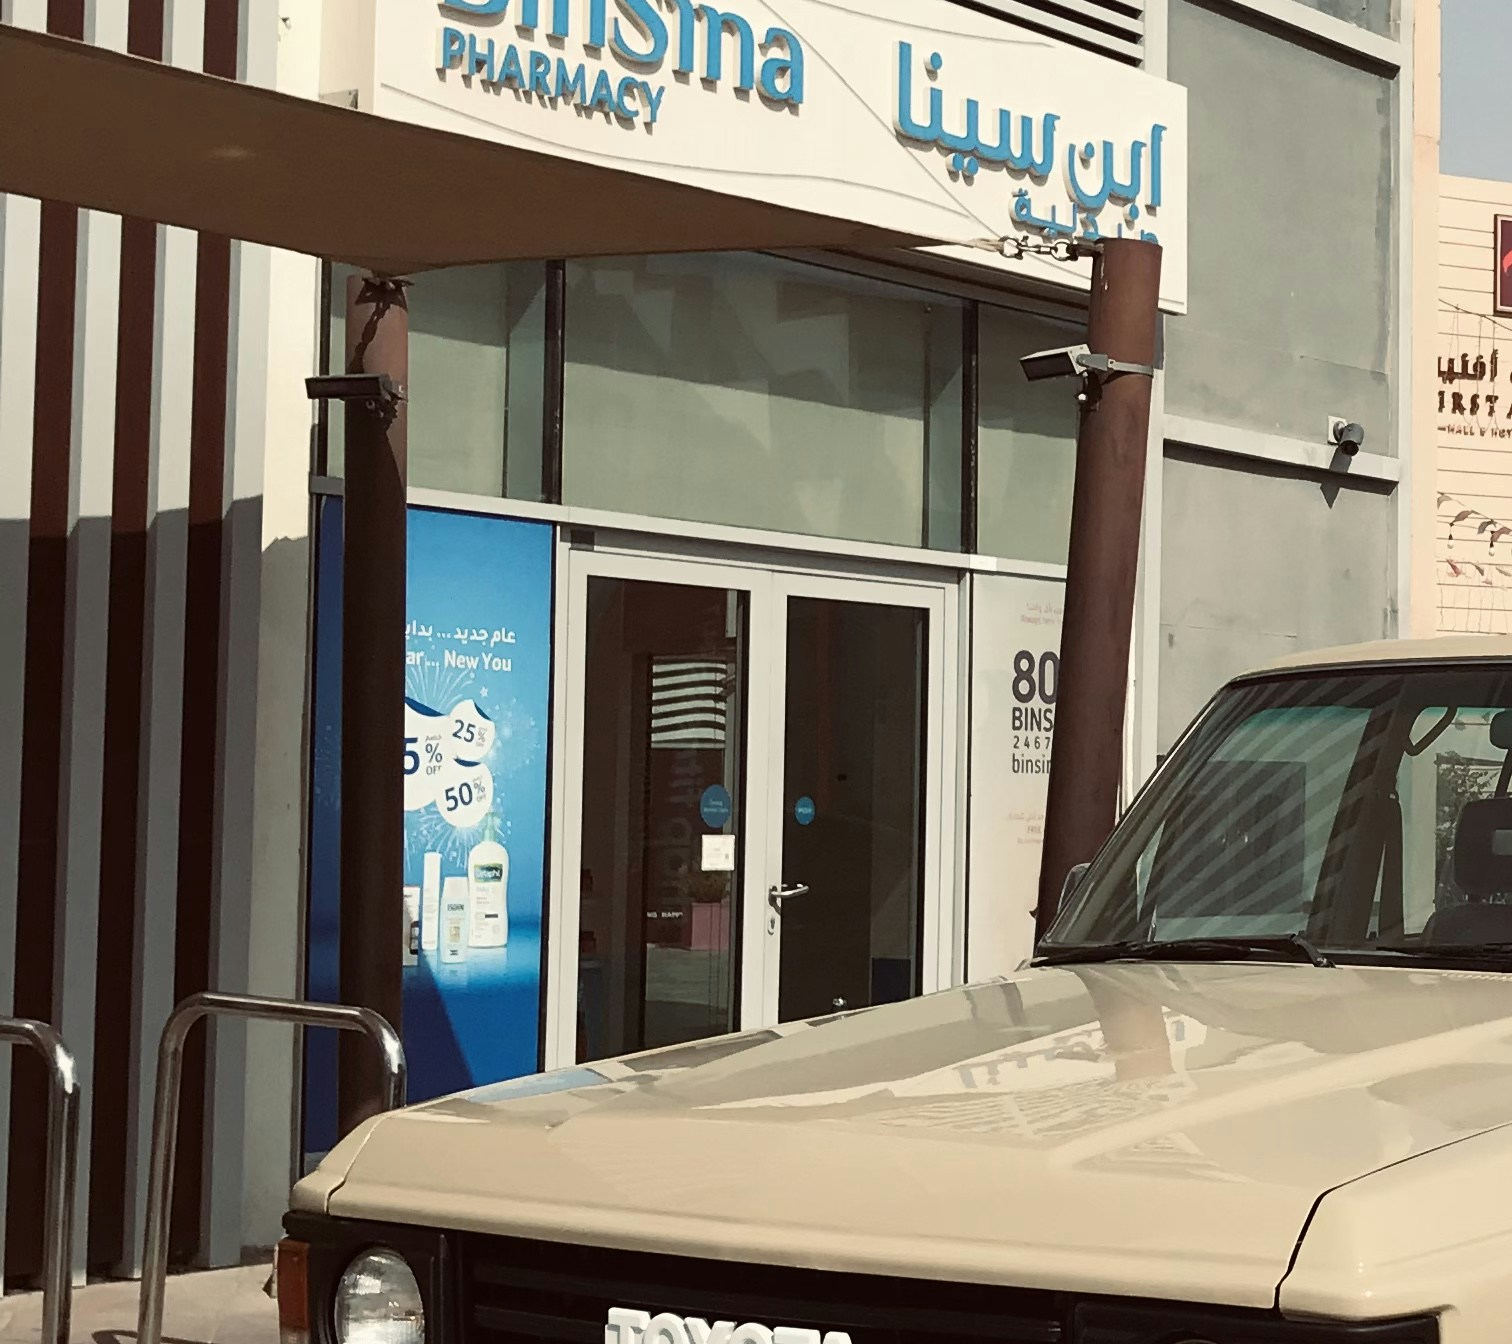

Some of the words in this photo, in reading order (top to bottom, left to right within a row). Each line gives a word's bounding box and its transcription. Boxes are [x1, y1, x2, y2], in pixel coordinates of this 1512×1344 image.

[439, 27, 667, 126] PHARMACY
[896, 40, 1061, 178] سينا
[1065, 123, 1168, 221] ابن
[490, 627, 516, 648] عام
[444, 649, 480, 670] New
[482, 652, 512, 673] You
[452, 719, 476, 743] 25
[445, 782, 473, 812] 50
